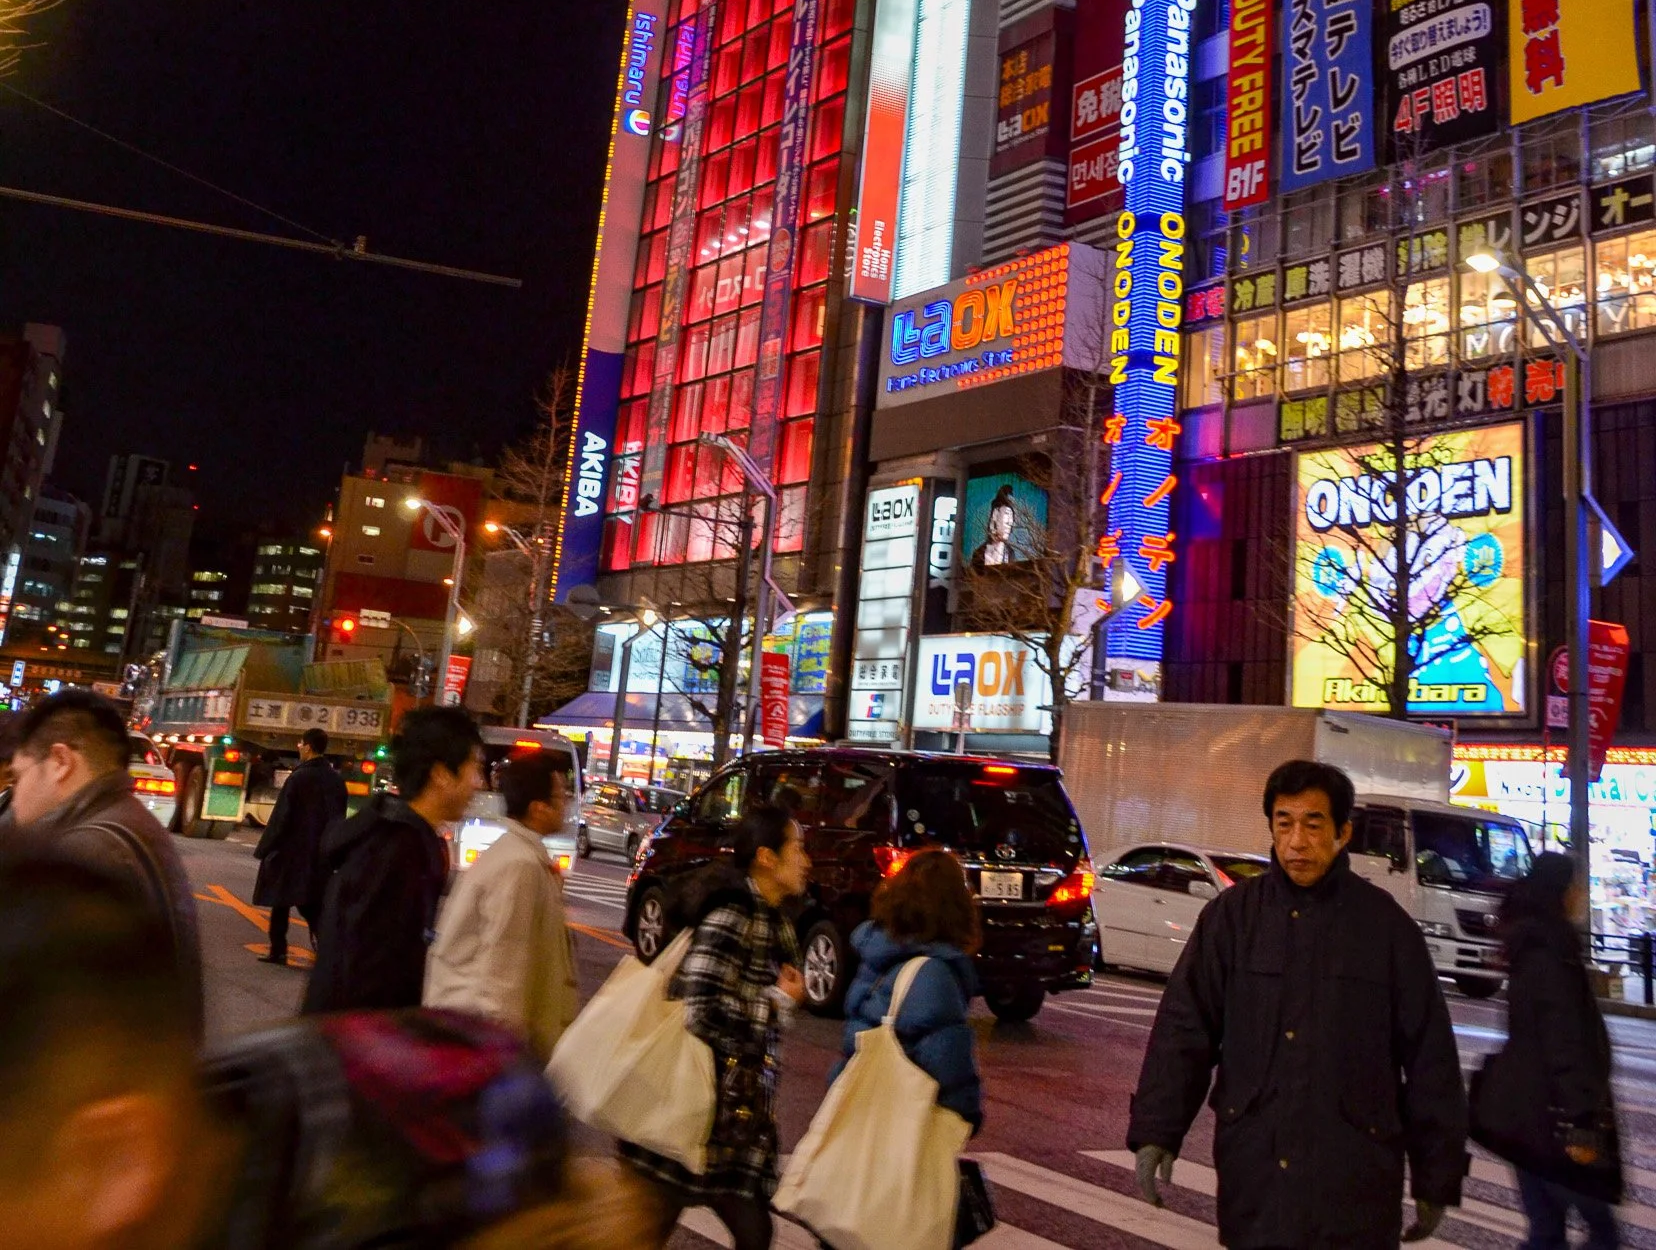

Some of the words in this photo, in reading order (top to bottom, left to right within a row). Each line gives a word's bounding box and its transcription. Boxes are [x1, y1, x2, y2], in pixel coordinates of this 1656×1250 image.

[624, 12, 657, 105] ishimaru
[1393, 67, 1487, 134] 4F照明
[1229, 69, 1265, 159] FREE
[1225, 158, 1266, 203] B1F
[1109, 210, 1136, 385] ONODEN
[1152, 212, 1184, 386] ONODEN
[574, 431, 607, 517] AKIBA
[1137, 416, 1182, 630] オノデン
[346, 709, 381, 728] 938
